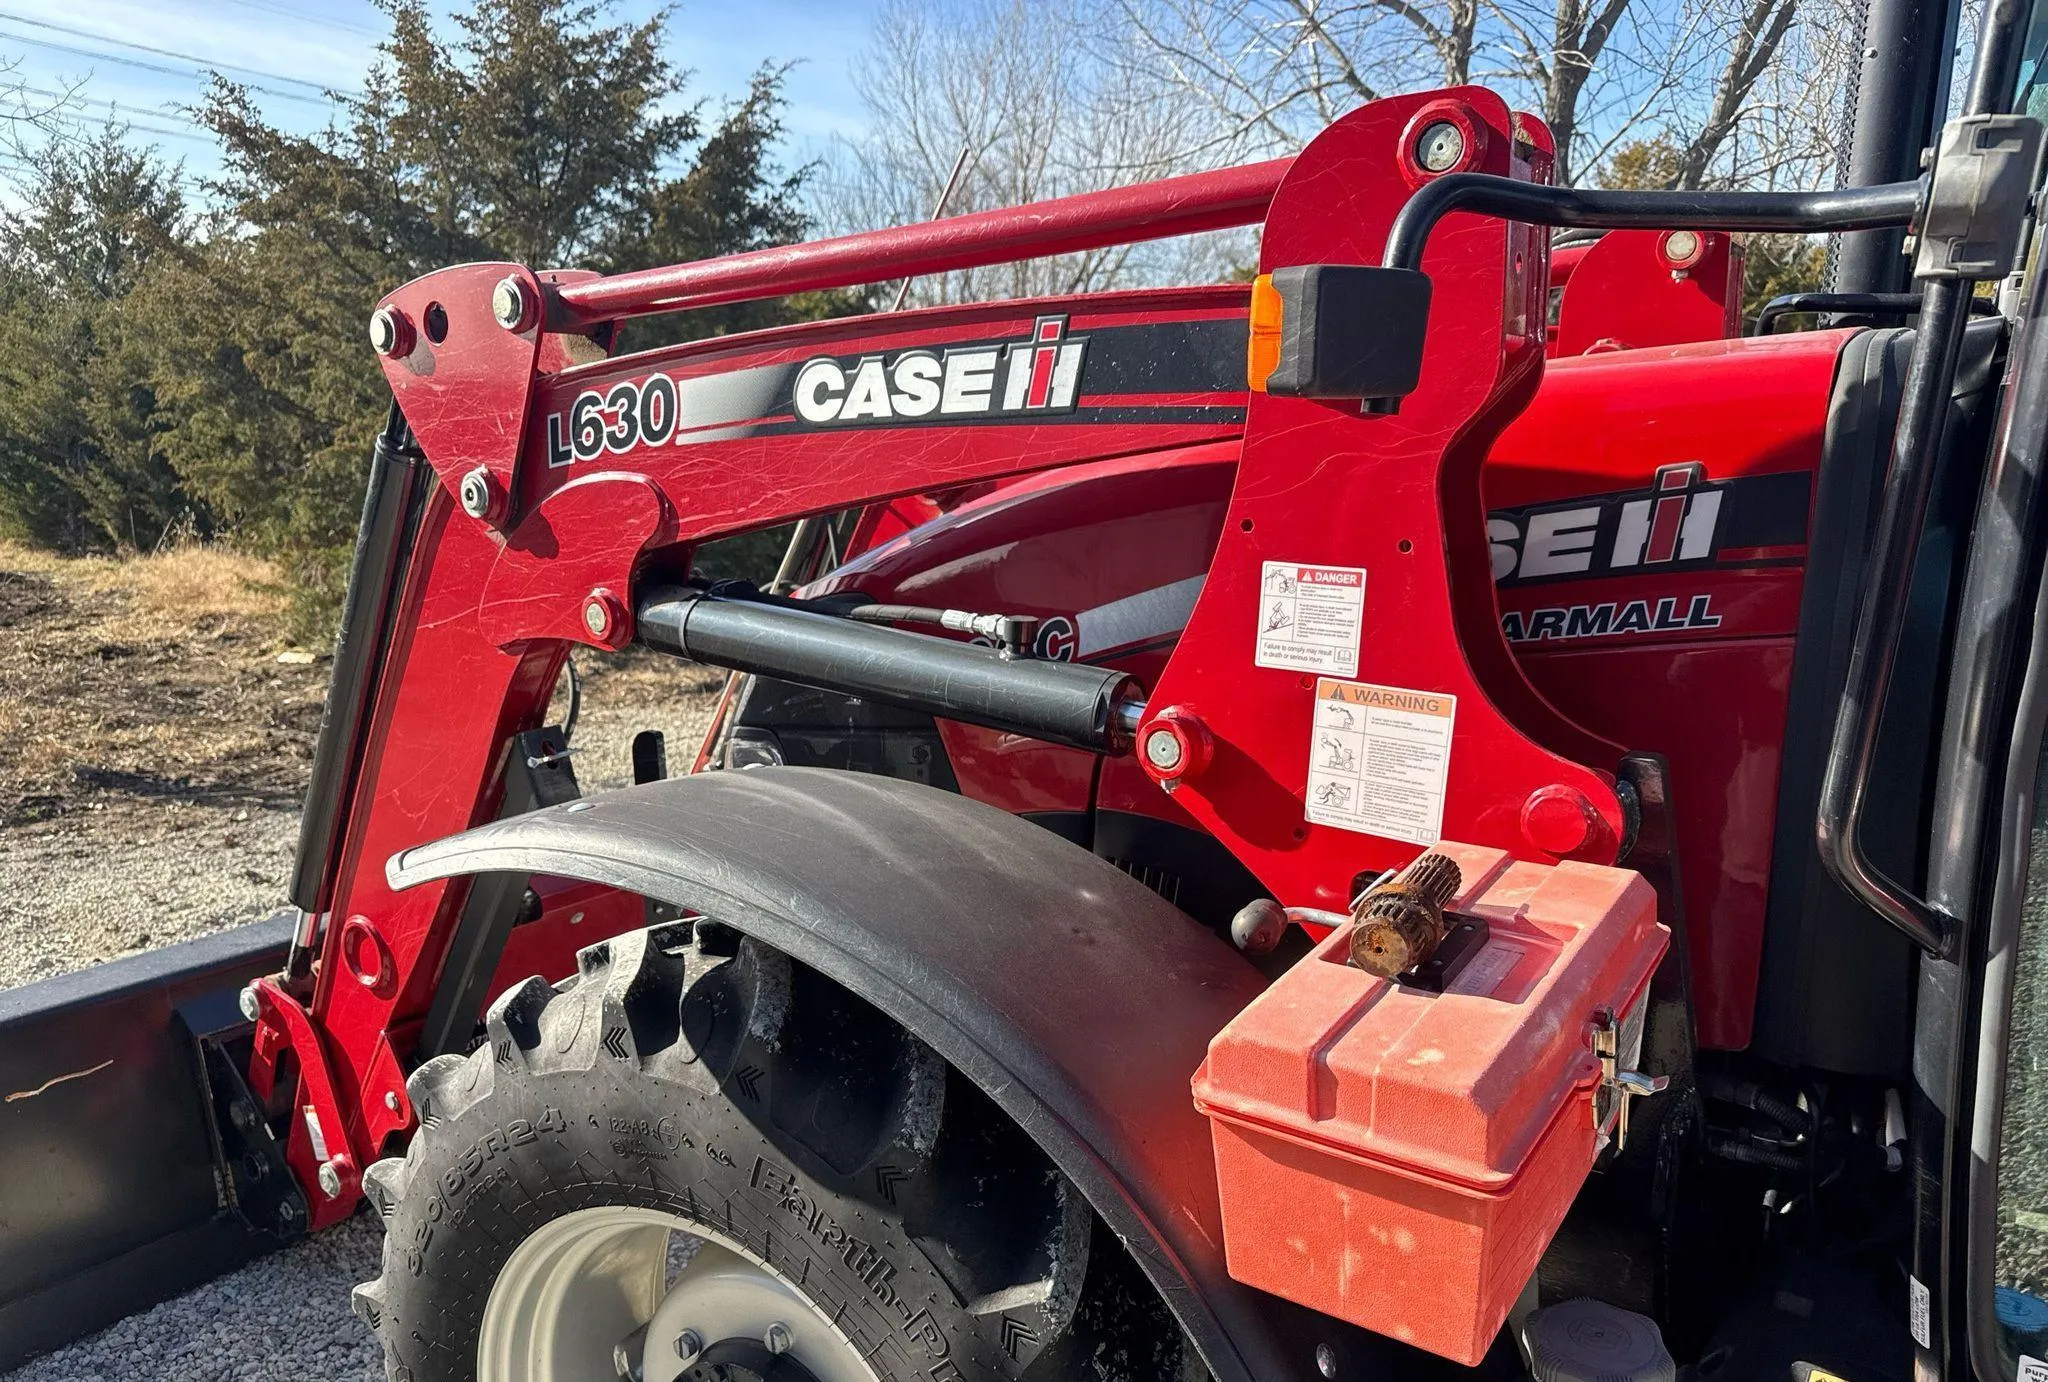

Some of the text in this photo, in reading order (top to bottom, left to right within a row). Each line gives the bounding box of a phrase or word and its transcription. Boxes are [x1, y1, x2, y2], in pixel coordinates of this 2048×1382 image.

[548, 373, 681, 469] L630
[795, 350, 998, 423] CASE
[1315, 571, 1358, 585] DANGER
[1487, 506, 1601, 581] SE
[1501, 594, 1723, 643] ARMALL
[1354, 688, 1440, 712] WARNING
[405, 1108, 568, 1278] 320/85R24
